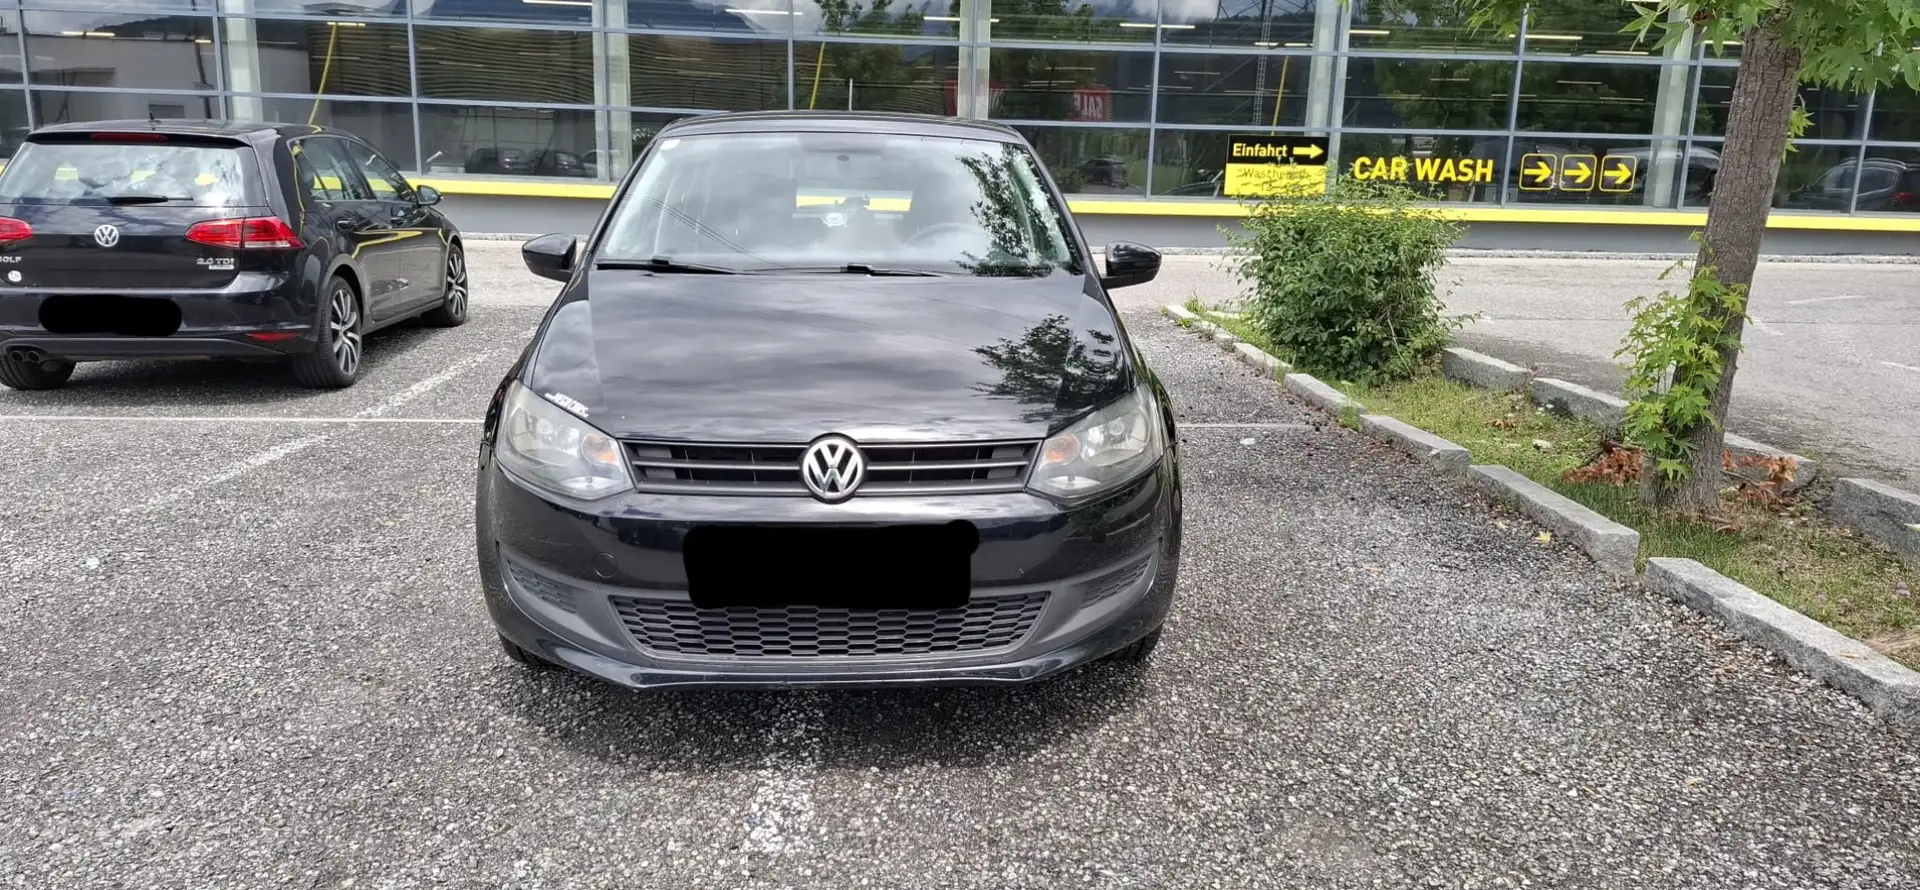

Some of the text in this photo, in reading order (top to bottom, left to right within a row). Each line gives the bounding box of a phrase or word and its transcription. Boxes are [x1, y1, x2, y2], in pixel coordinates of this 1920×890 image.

[1232, 143, 1288, 157] Einfahrt
[1353, 156, 1494, 182] CAR WASH
[94, 224, 119, 247] VW
[803, 436, 863, 499] VW
